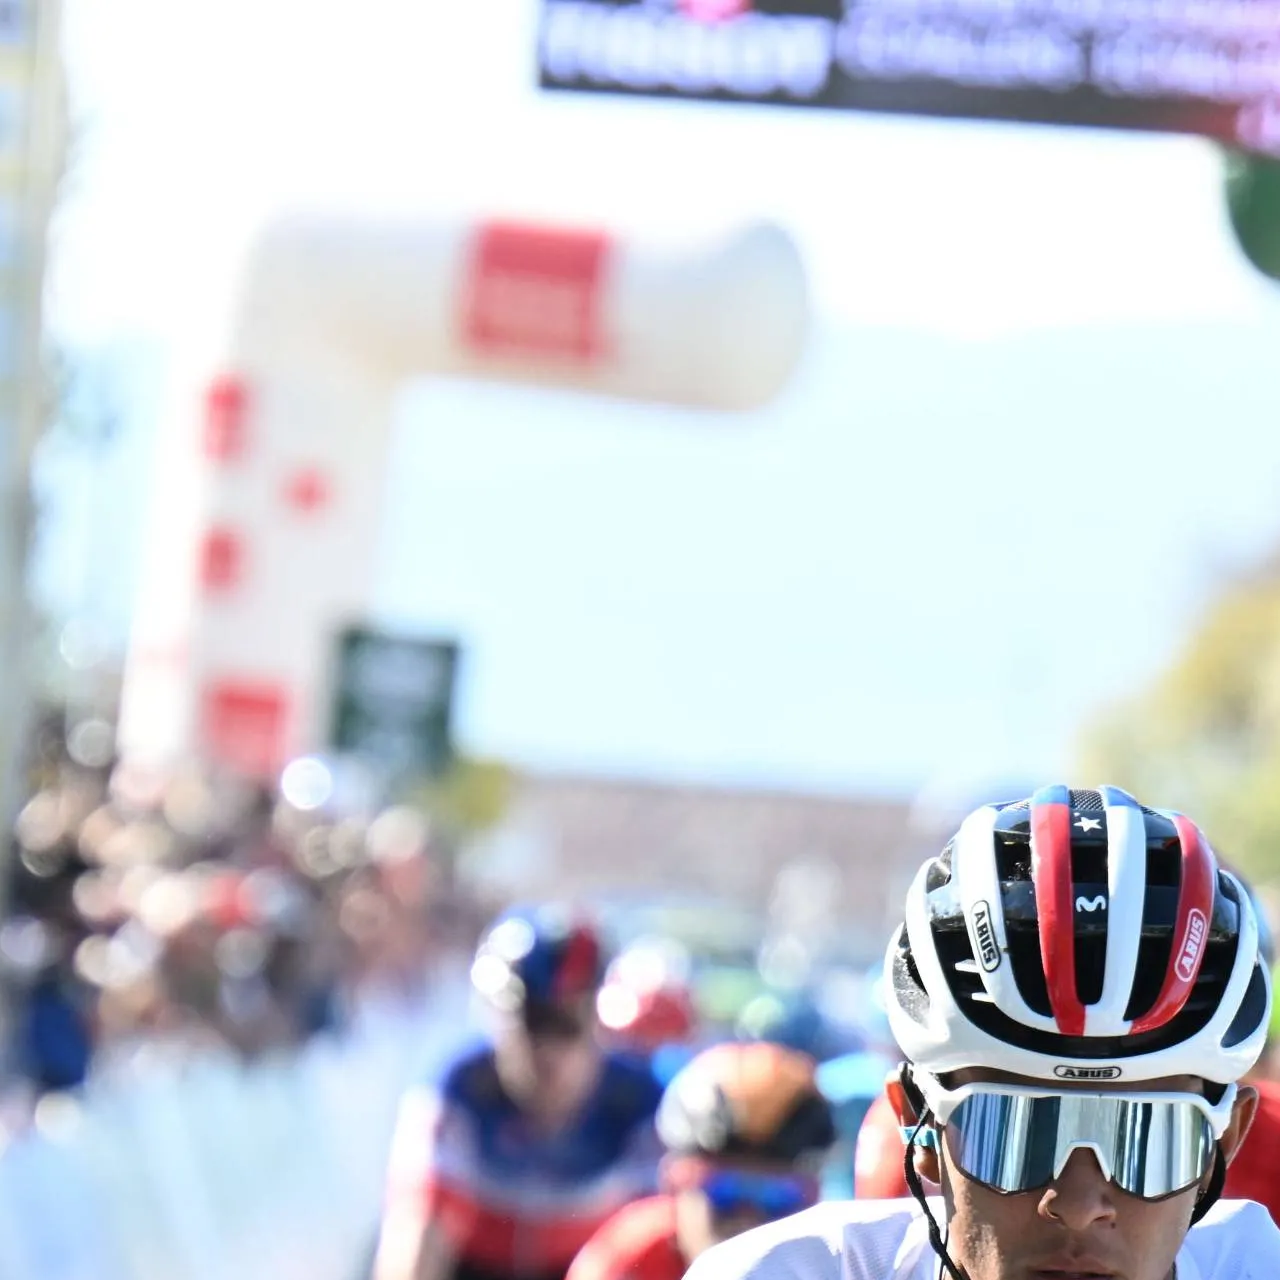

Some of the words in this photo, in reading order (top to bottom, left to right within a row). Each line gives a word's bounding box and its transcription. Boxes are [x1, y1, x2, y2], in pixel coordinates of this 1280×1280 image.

[974, 909, 998, 965] ABUS
[1181, 915, 1204, 975] ABUS
[1063, 1068, 1115, 1078] ABUS
